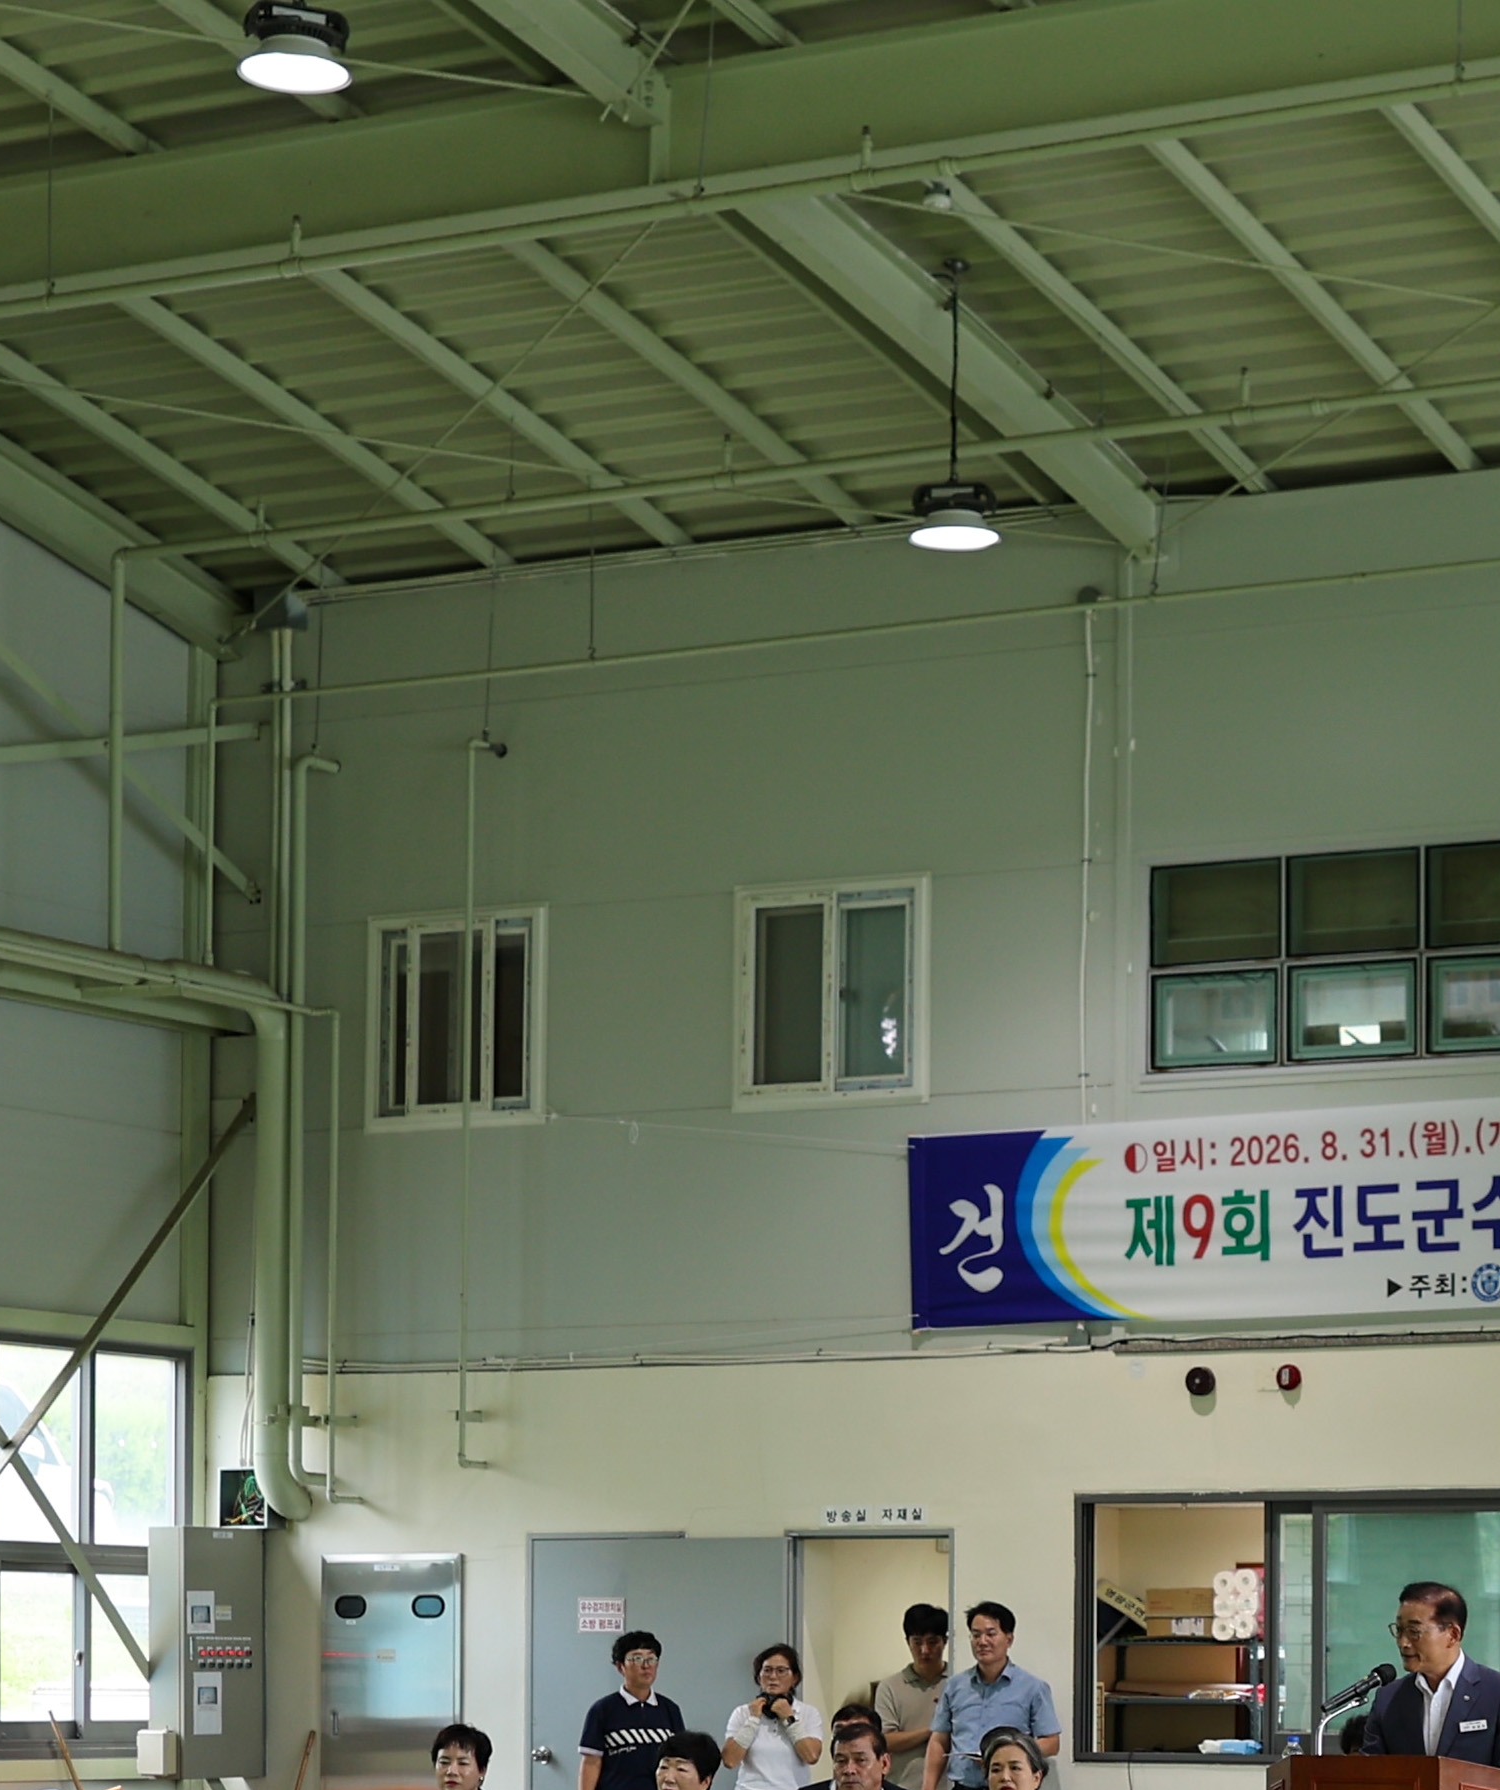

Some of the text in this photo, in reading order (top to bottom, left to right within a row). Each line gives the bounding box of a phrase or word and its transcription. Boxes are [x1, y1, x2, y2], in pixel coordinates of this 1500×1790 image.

[1152, 1138, 1217, 1172] 일시:
[1230, 1133, 1309, 1166] 2026.
[1321, 1131, 1347, 1161] 8.
[939, 1183, 1004, 1293] 건
[1124, 1189, 1271, 1266] 제9회
[1409, 1273, 1467, 1298] 주최:
[826, 1509, 867, 1523] 방송실
[882, 1507, 923, 1521] 자재실
